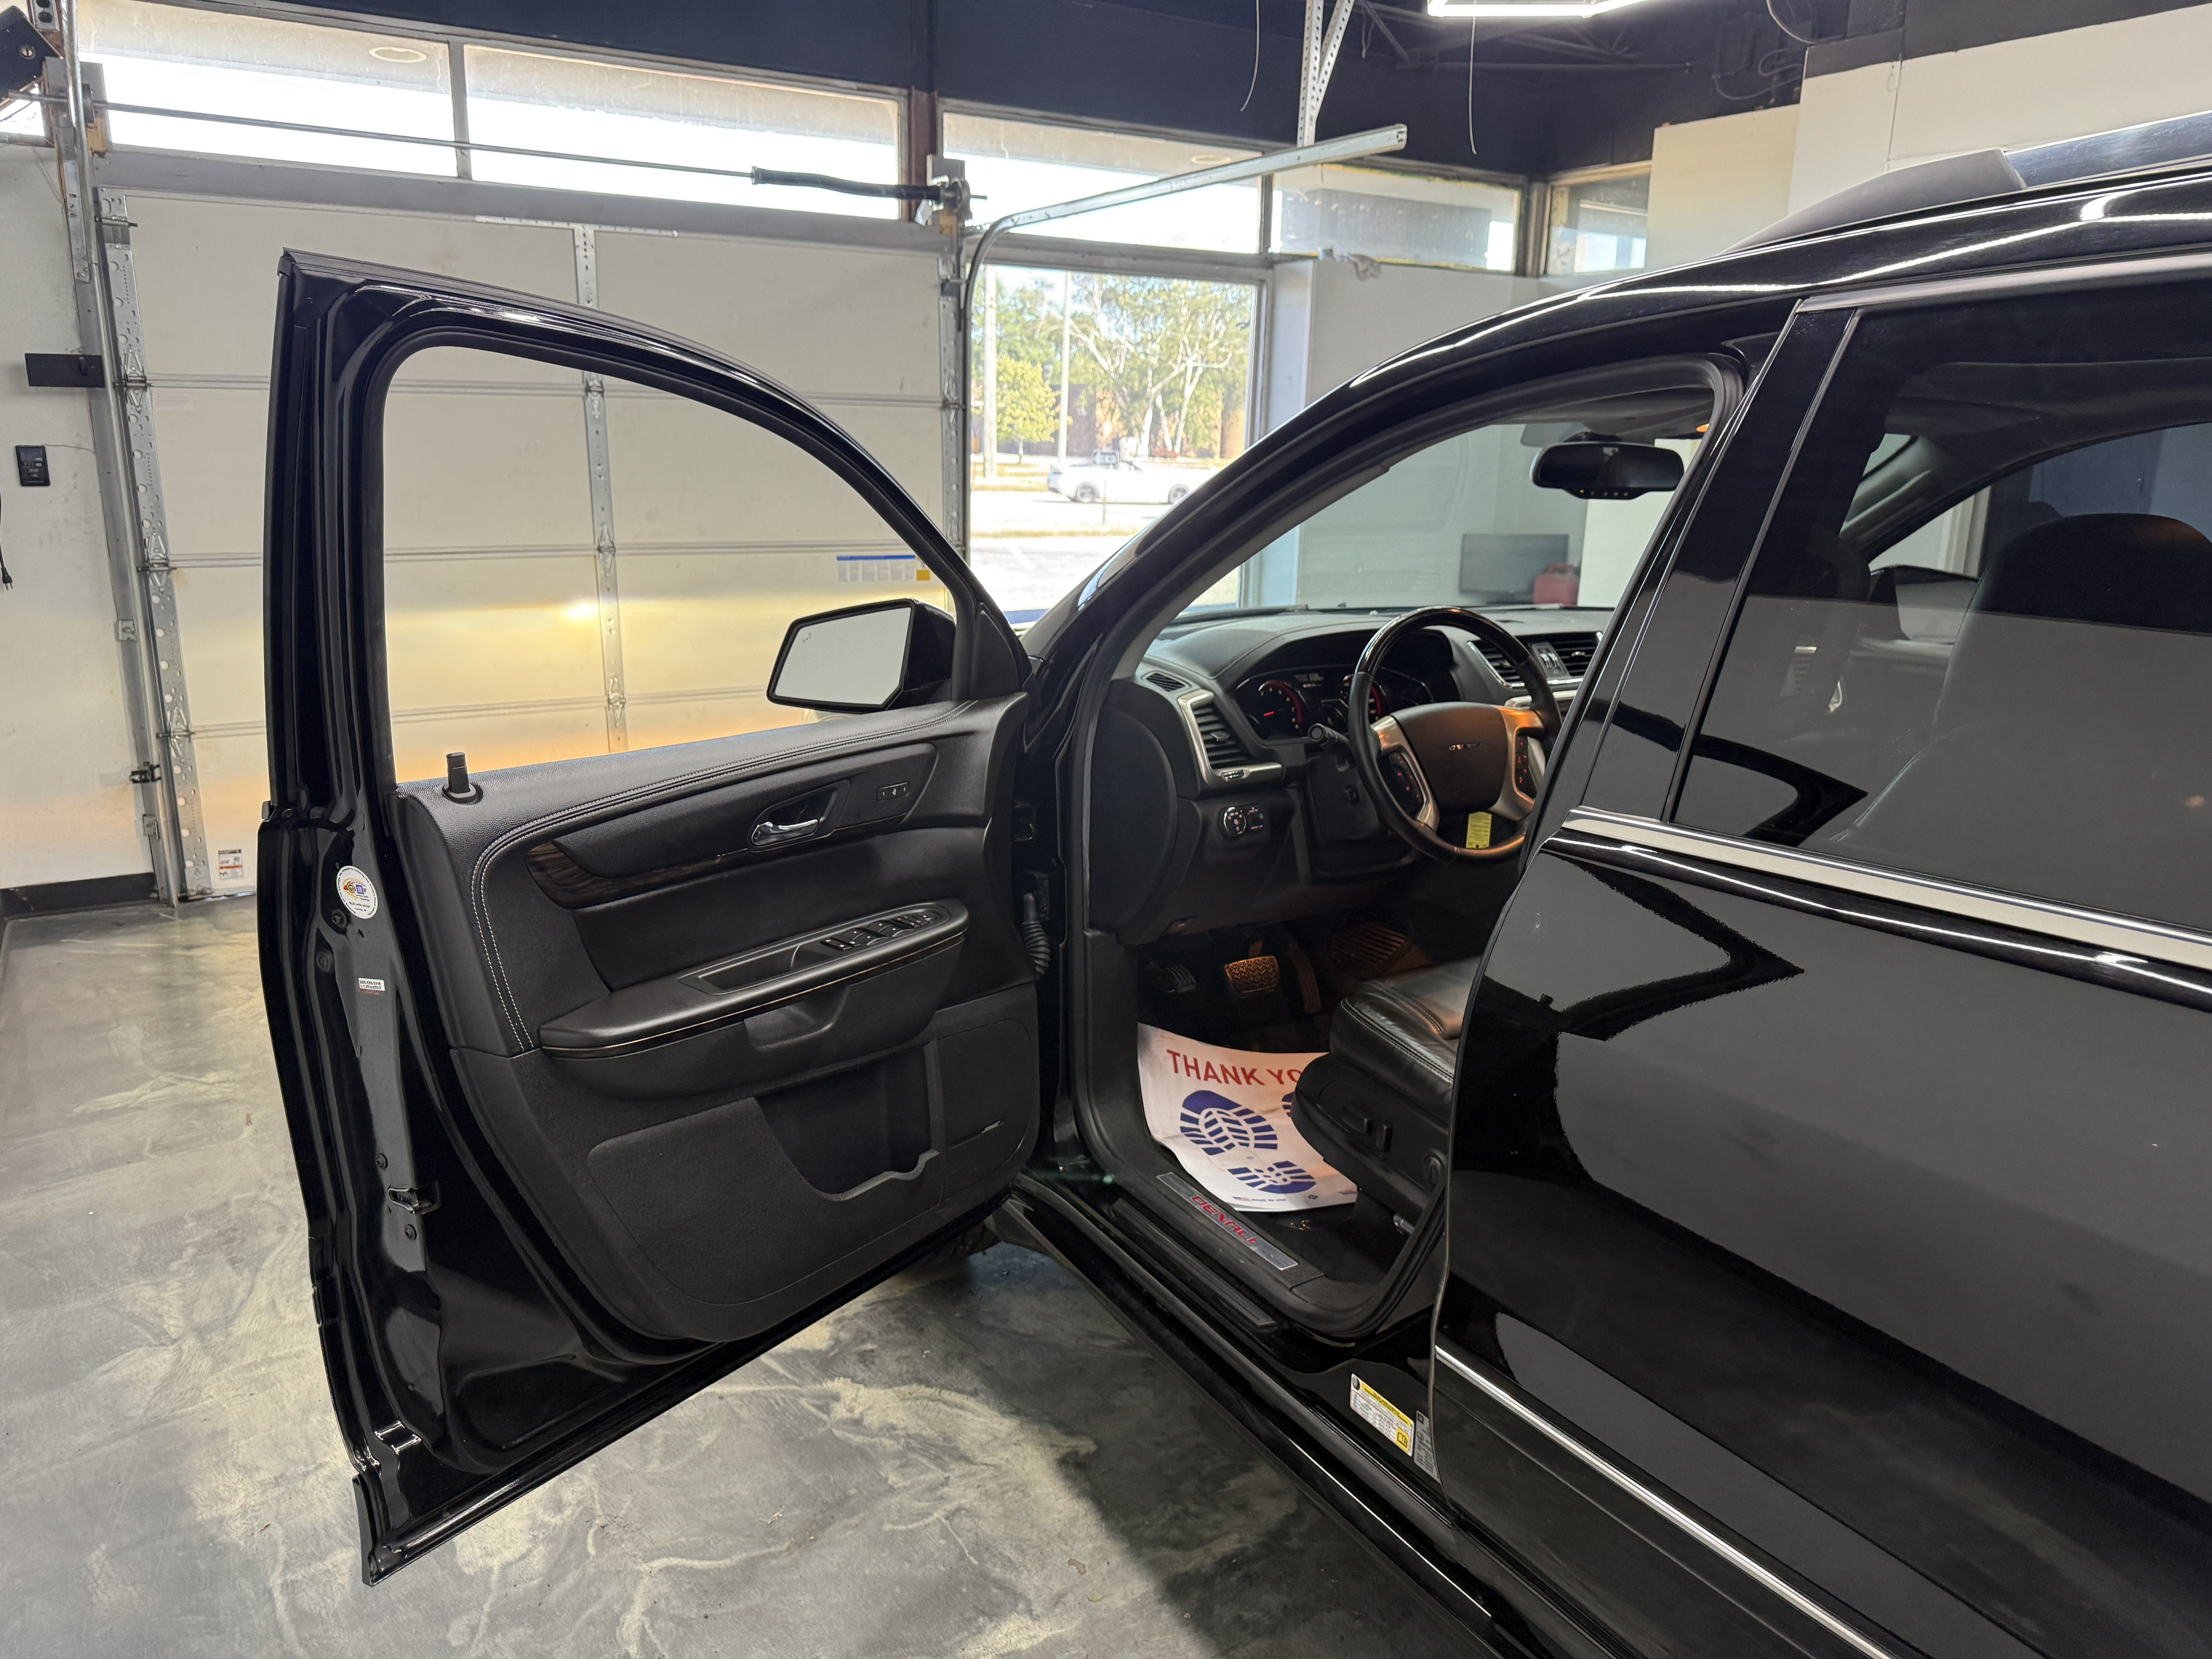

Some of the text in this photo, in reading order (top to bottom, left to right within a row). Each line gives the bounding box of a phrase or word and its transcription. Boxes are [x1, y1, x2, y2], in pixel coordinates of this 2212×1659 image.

[1166, 1049, 1303, 1085] THANK YO
[1191, 1195, 1257, 1243] DENALI
